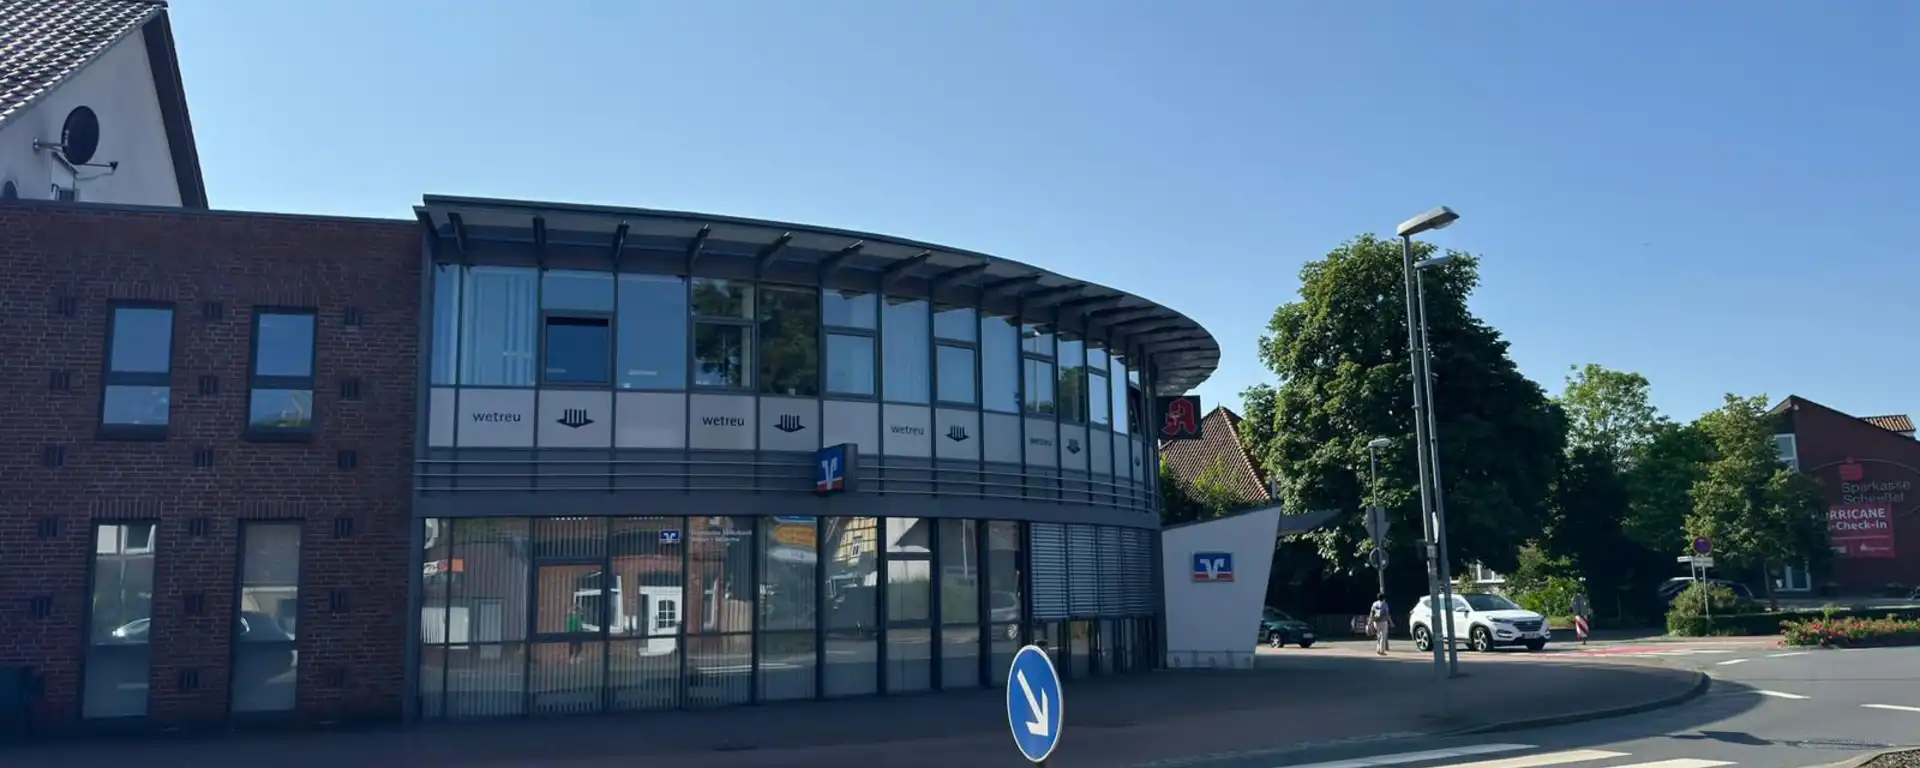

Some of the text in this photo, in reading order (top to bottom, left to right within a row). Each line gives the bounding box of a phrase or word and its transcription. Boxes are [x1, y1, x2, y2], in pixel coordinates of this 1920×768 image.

[472, 411, 521, 422] wetreu
[702, 415, 745, 427] wetreu
[890, 424, 924, 435] wetreu
[1842, 480, 1911, 494] Sparkasse
